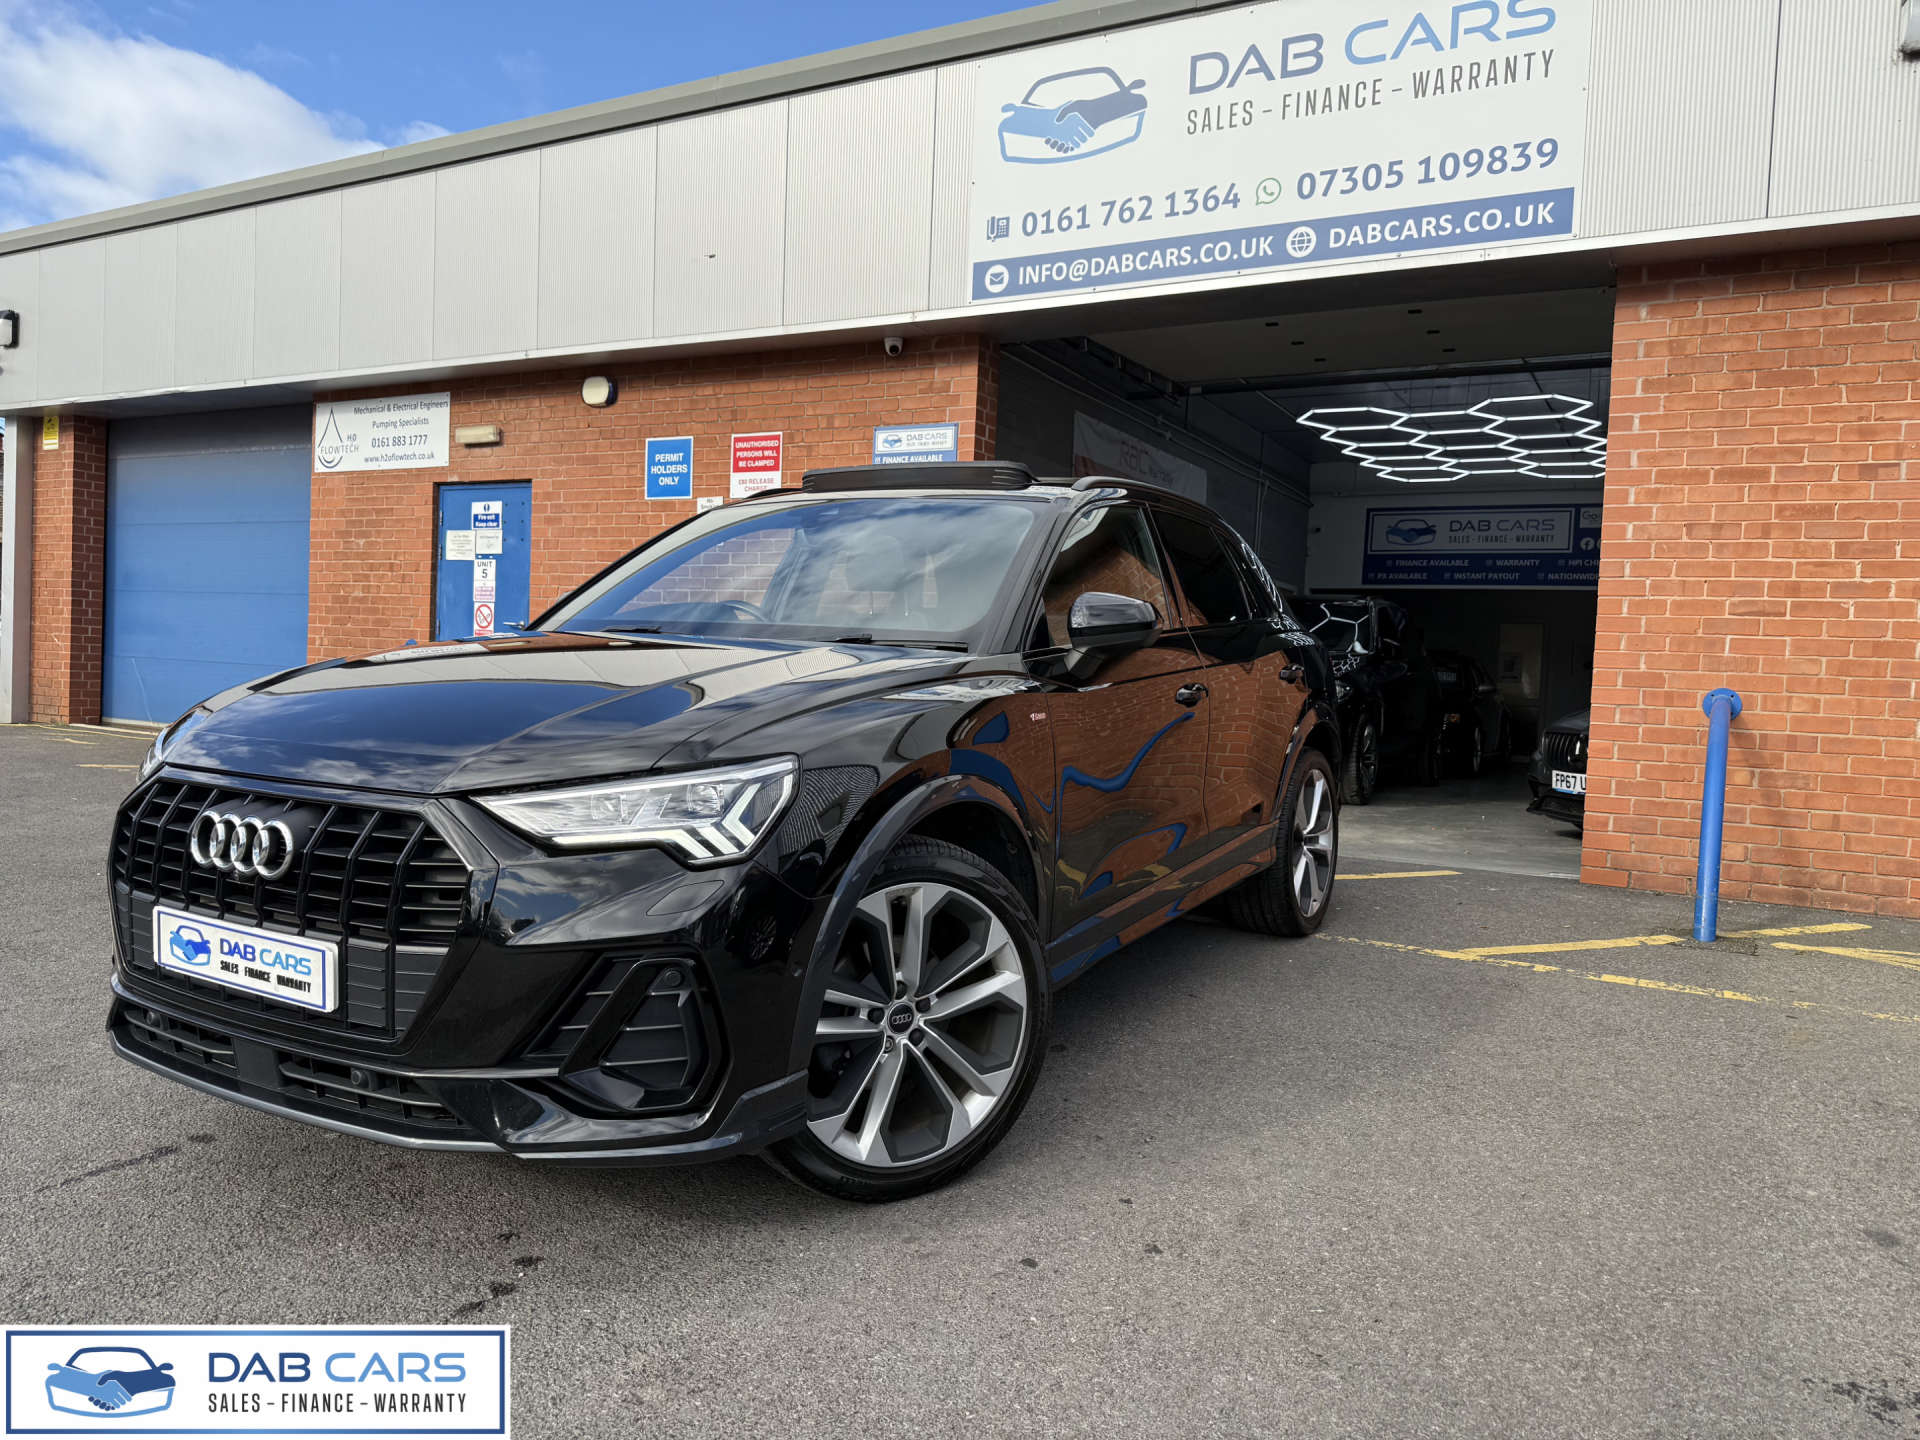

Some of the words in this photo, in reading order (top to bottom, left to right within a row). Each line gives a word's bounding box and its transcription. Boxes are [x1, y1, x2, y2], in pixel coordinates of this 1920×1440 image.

[1188, 33, 1324, 95] DAB
[1344, 0, 1556, 66] CARS
[1187, 99, 1254, 135] SALES
[1281, 78, 1383, 121] FINANCE
[1412, 49, 1555, 100] WARRANTY
[1297, 159, 1405, 200] 07305
[1417, 137, 1559, 185] 109839
[1021, 211, 1091, 238] 0161
[1101, 196, 1154, 226] 762
[1164, 182, 1241, 218] 1364
[1329, 201, 1555, 249] DABCARS.CO.UK
[1018, 235, 1274, 286] INFO@DABCARS.CO.UK
[354, 404, 386, 415] Mechanical
[387, 403, 392, 412] &
[393, 402, 419, 412] Electrical
[420, 400, 449, 411] Engineers
[372, 419, 398, 429] Pumping
[399, 417, 430, 428] Specialists
[371, 438, 390, 449] 0161
[392, 436, 406, 447] 883
[408, 434, 428, 446] 1777
[655, 453, 684, 463] PERMIT
[736, 450, 762, 458] PERSONS
[882, 456, 910, 464] FINANCE
[650, 464, 688, 475] HOLDERS
[747, 459, 775, 468] CLAMPED
[658, 476, 680, 486] ONLY
[749, 477, 775, 485] RELEASE
[1449, 520, 1492, 532] DAB
[1496, 519, 1555, 532] CARS
[1477, 535, 1508, 544] FINANCE
[1516, 534, 1555, 543] WARRANTY
[1395, 559, 1429, 567] FINANCE
[1429, 559, 1470, 567] AVAILABLE
[1496, 559, 1540, 567] WARRANTY
[481, 569, 488, 579] 5
[1556, 774, 1576, 789] FP67
[219, 938, 256, 962] DAB
[259, 948, 312, 976] CARS
[220, 960, 239, 975] SALES
[244, 967, 271, 982] FINANCE
[276, 975, 312, 993] WARRANTY
